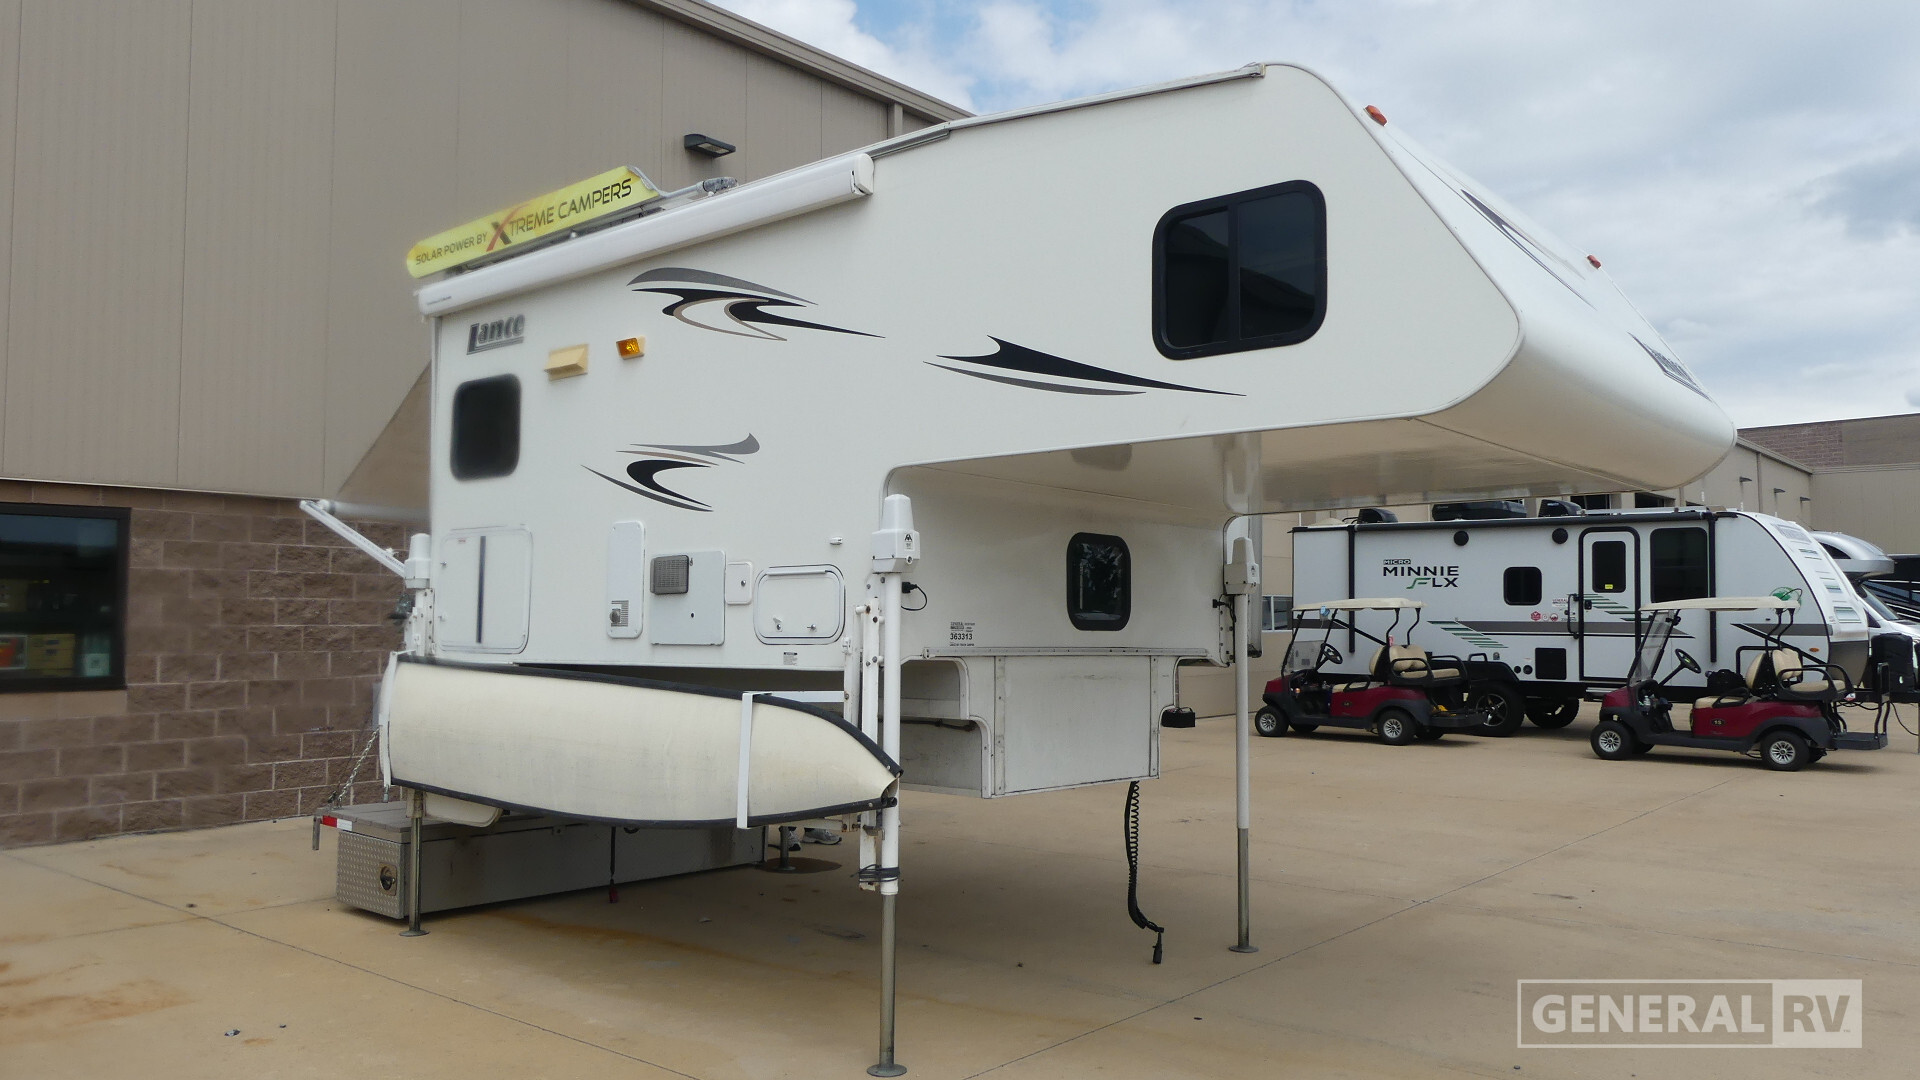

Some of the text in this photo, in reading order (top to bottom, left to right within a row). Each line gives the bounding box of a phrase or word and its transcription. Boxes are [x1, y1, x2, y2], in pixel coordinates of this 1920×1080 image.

[415, 178, 633, 266] SOLAR POWER BY XTREME CAMPERS
[466, 313, 526, 355] Lance
[1382, 566, 1460, 577] MINNIE
[1406, 577, 1459, 589] FLX
[950, 632, 973, 640] 363313
